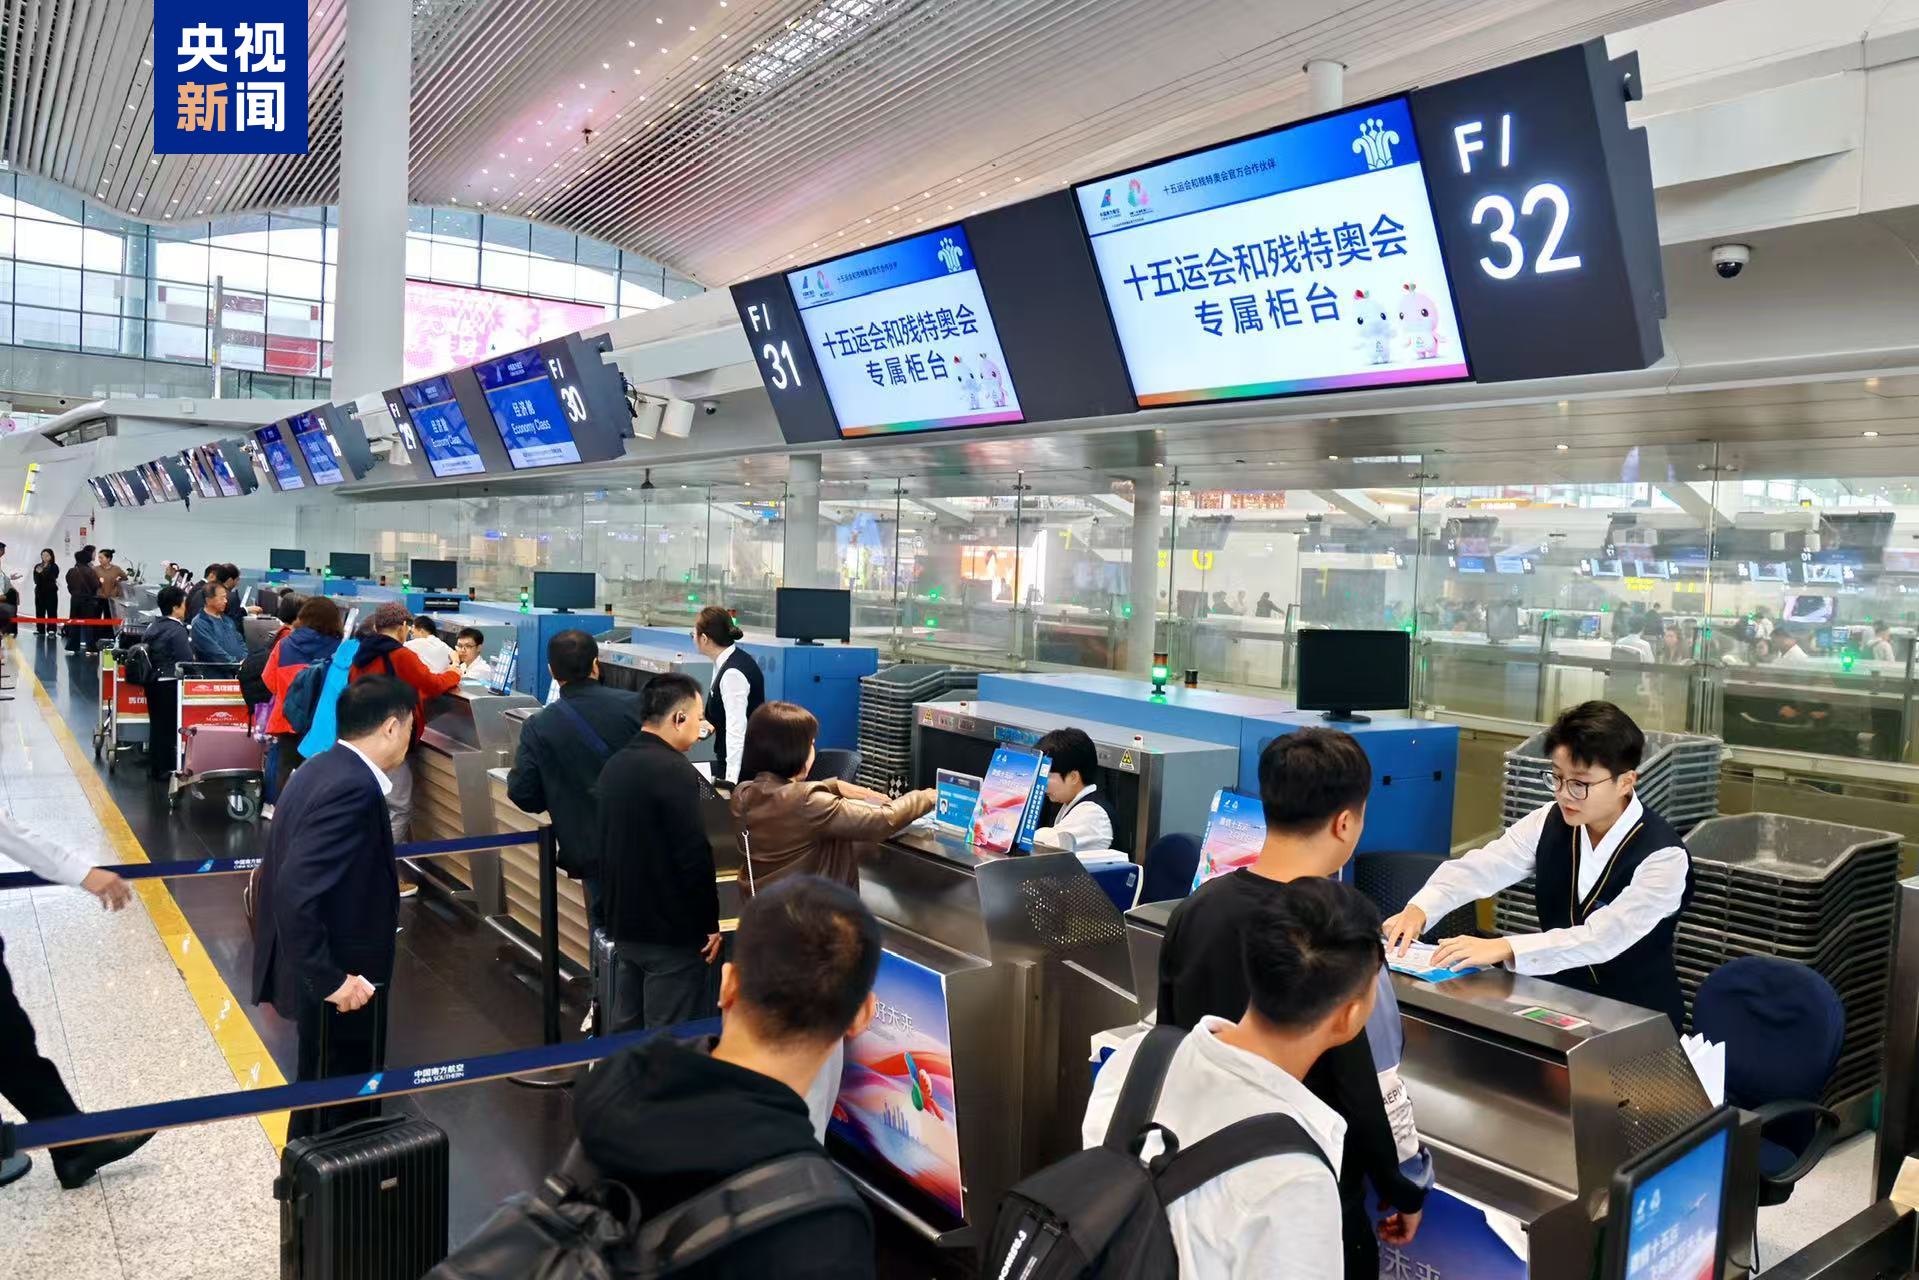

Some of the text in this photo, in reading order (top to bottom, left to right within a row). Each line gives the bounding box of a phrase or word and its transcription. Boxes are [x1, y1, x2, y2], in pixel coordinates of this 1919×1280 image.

[1471, 183, 1582, 280] 32
[1124, 213, 1408, 301] 十五运会和残特奥会
[822, 303, 979, 359] 十五运会和残特奥会
[1194, 282, 1340, 337] 专属柜台
[763, 340, 801, 389] 31
[866, 350, 949, 387] 专属柜台
[560, 386, 587, 423] 30
[511, 418, 551, 436] Economy Class
[413, 1072, 464, 1085] CHINA SOUTHERN
[414, 1063, 464, 1079] 中国南方航空
